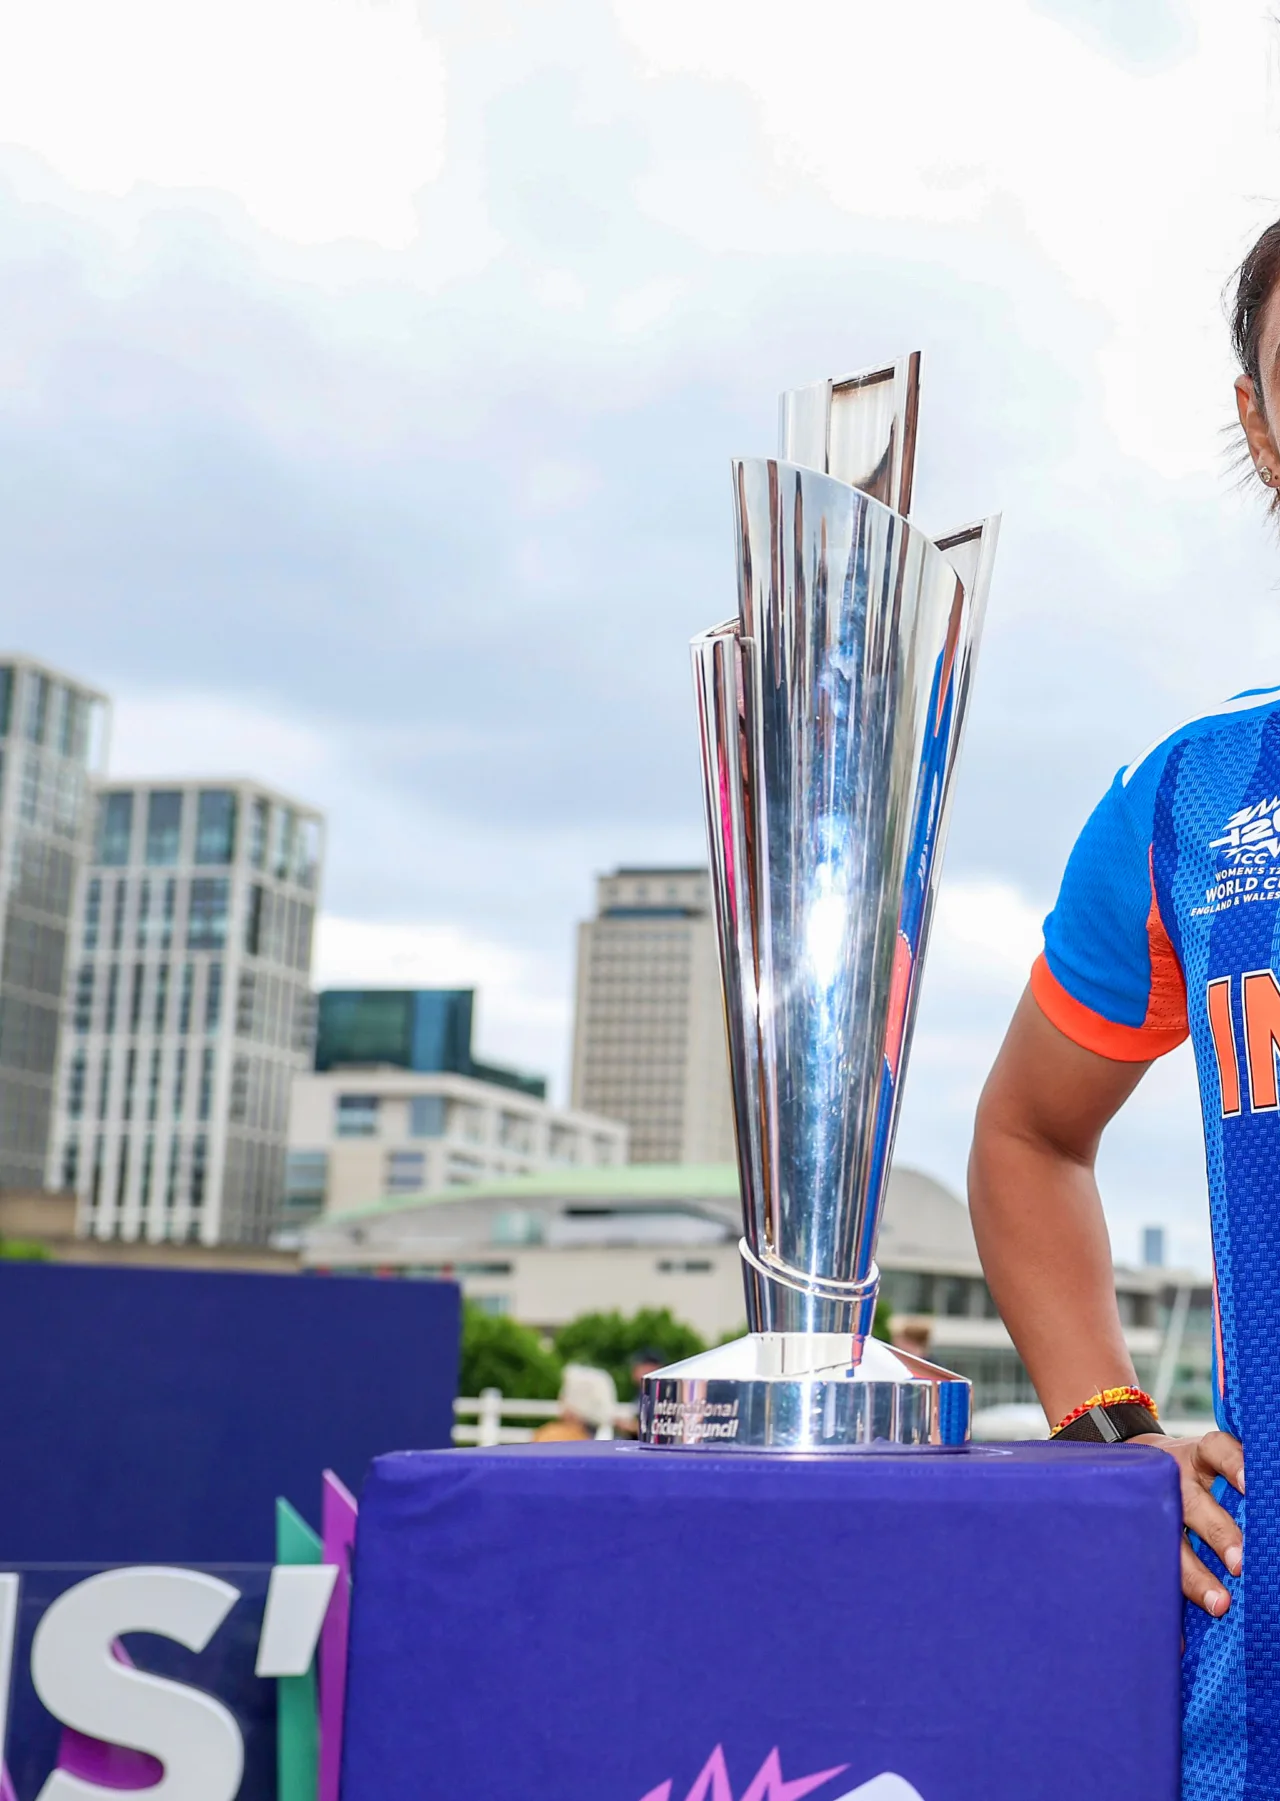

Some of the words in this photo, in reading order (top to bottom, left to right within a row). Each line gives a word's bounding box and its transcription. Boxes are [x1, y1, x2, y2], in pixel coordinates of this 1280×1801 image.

[1234, 853, 1269, 864] ICC
[1215, 867, 1265, 882] WOMEN'S
[1205, 878, 1259, 903] WORLD
[1190, 900, 1232, 917] ENGLAND
[1233, 896, 1240, 906] &
[1243, 891, 1280, 903] WALES
[654, 1398, 739, 1418] International
[651, 1418, 684, 1435] Cricket
[687, 1419, 739, 1437] Council
[0, 1563, 339, 1801] S'
